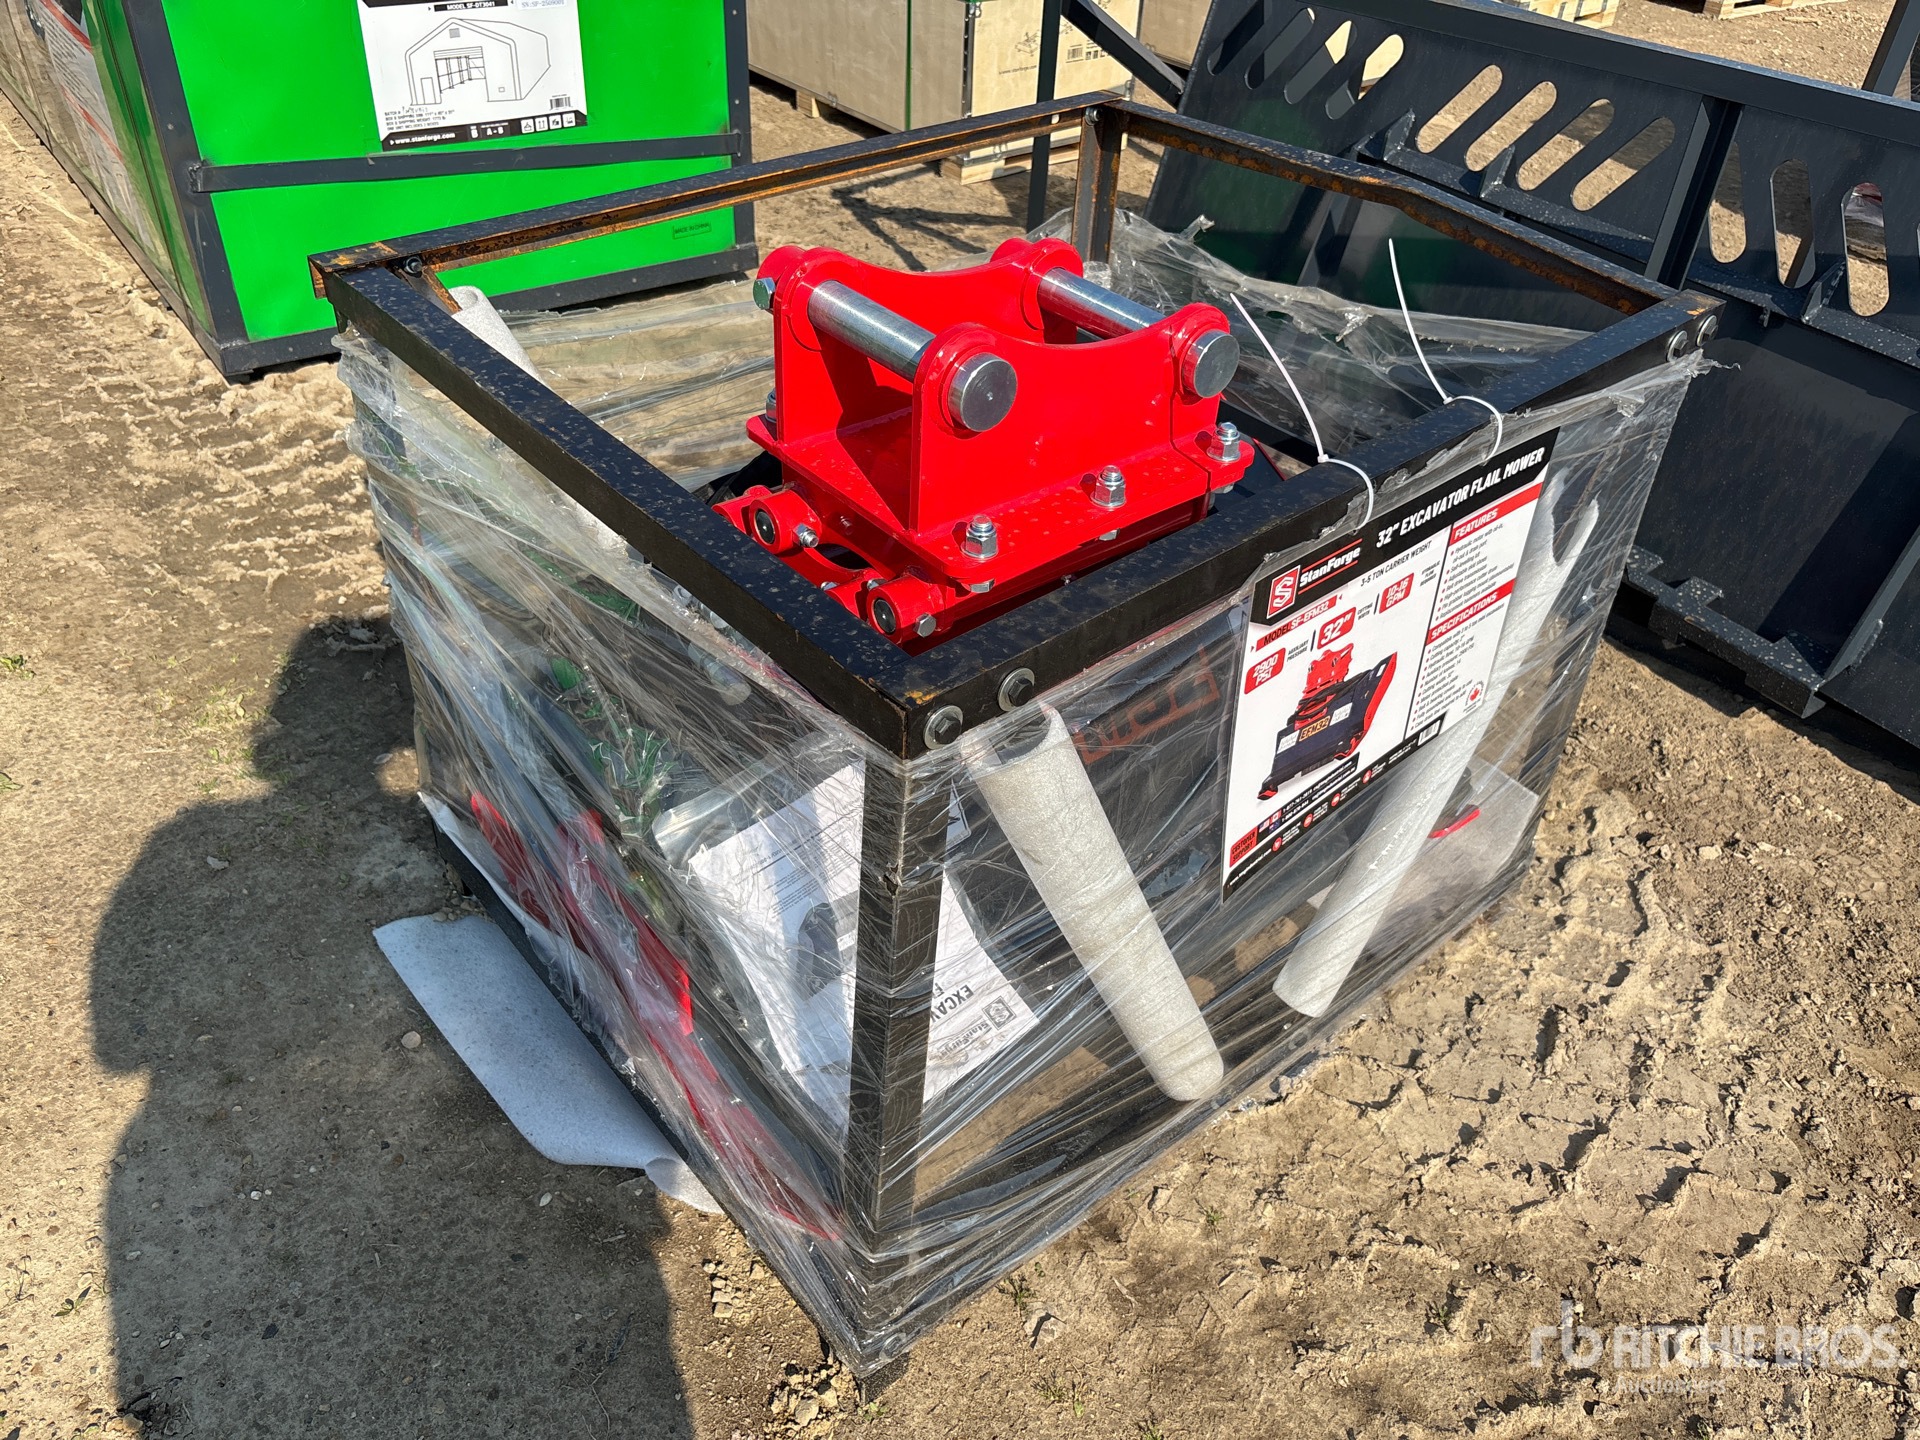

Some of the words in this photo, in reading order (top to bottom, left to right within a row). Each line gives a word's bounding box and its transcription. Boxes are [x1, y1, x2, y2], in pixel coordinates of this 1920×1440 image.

[447, 2, 466, 10] MODEL
[395, 132, 456, 145] www.stanforge.com
[1400, 485, 1470, 536] EXCAVATOR
[1469, 470, 1502, 504] FLAIL
[1503, 446, 1546, 485] MOWER
[1454, 508, 1499, 540] FEATURES
[1299, 547, 1361, 588] StanForge
[1372, 569, 1384, 581] TON
[1385, 554, 1410, 573] CARRIER
[1410, 540, 1432, 559] WEIGHT
[1386, 589, 1406, 609] GPM
[1263, 620, 1290, 646] MODEL
[1290, 601, 1330, 630] SF-EFM32
[1319, 612, 1353, 646] 32"
[1431, 592, 1497, 639] SPECIFICATIONS
[1253, 654, 1279, 678] 2900
[1255, 667, 1273, 687] PSI
[1300, 717, 1329, 740] EFM32
